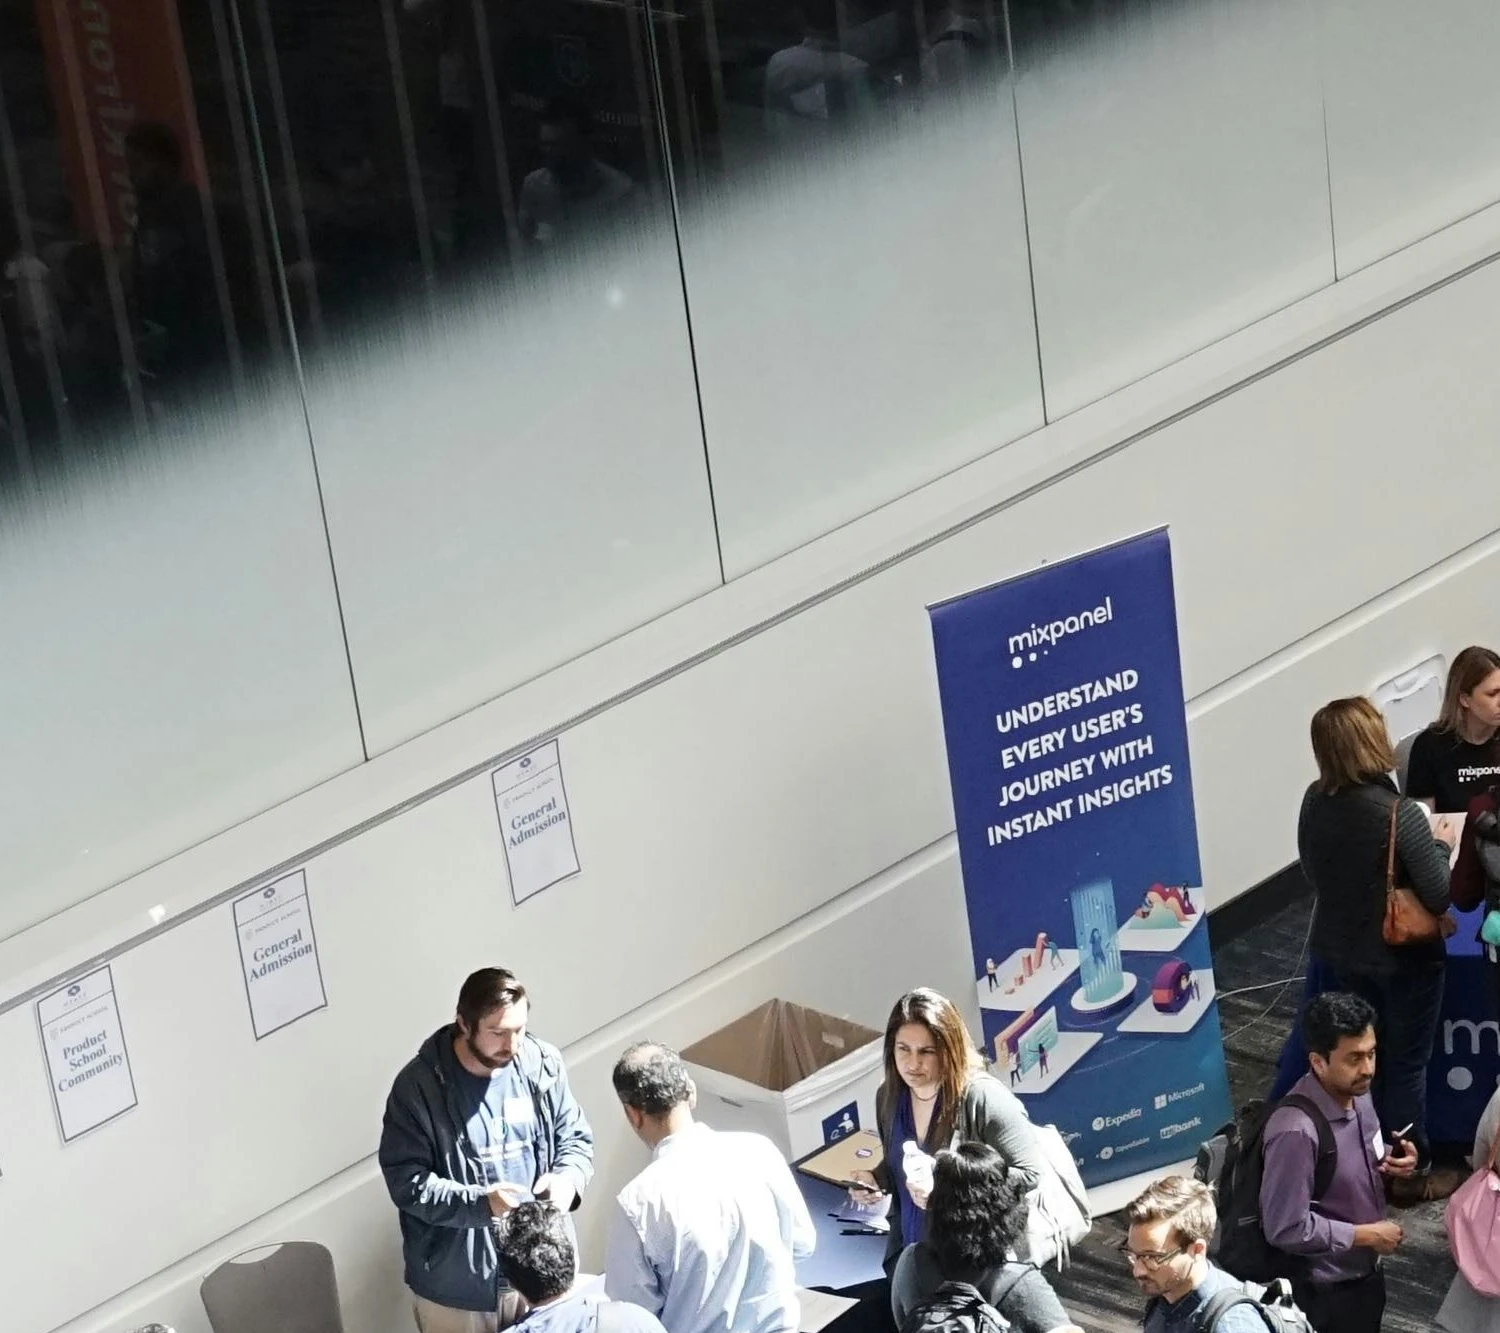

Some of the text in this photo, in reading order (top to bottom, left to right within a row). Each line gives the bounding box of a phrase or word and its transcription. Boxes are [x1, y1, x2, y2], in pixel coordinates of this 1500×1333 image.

[1008, 597, 1113, 654] mixpanel
[996, 669, 1139, 733] UNDERSTAND
[1002, 704, 1143, 769] EVERY USER'S
[999, 736, 1153, 807] JOURNEY WITH
[511, 796, 557, 831] General
[987, 765, 1173, 847] INSTANT INSIGHTS
[508, 811, 566, 850] Admission
[249, 943, 313, 983] Admission
[253, 928, 303, 963] General
[63, 1029, 108, 1060] Product
[69, 1044, 107, 1072] School
[58, 1052, 124, 1092] Community
